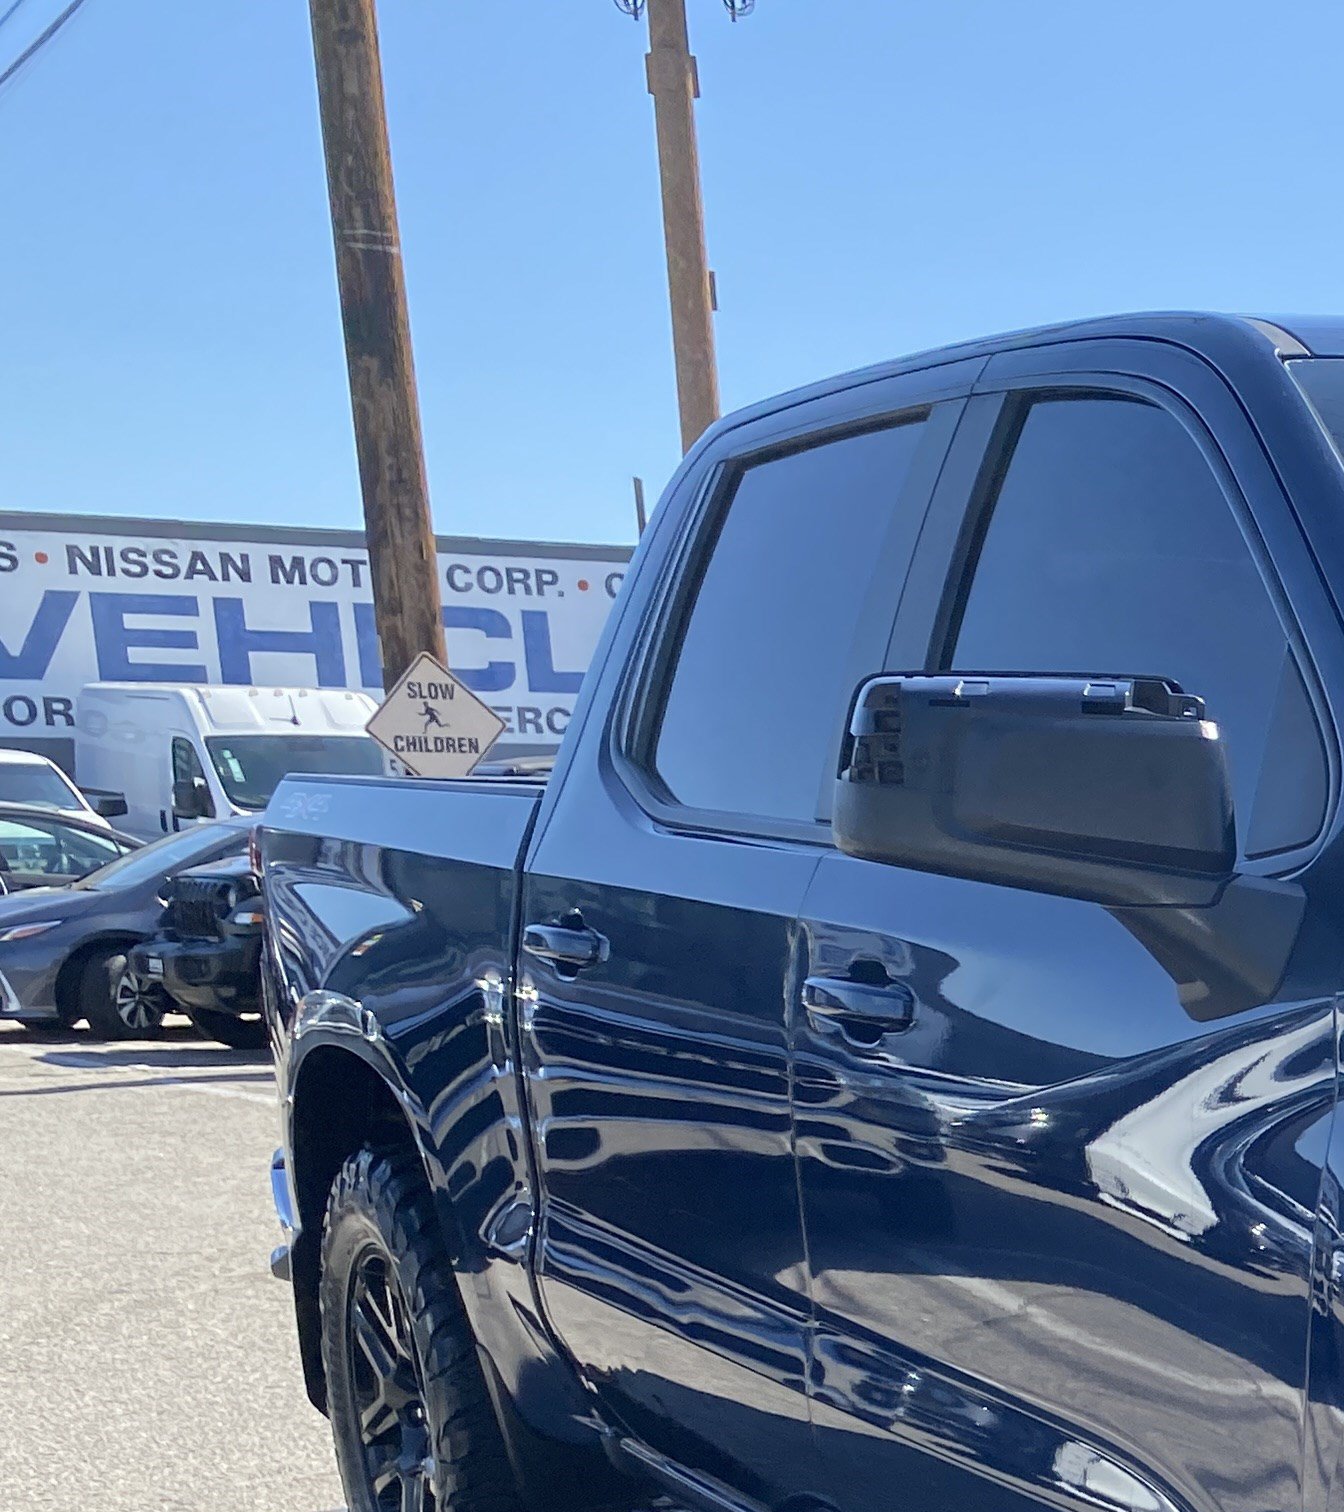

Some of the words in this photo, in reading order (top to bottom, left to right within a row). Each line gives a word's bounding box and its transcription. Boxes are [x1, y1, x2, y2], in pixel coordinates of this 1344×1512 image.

[65, 544, 252, 583] NISSAN
[268, 554, 368, 588] MOT
[446, 563, 565, 598] CORP.
[0, 589, 588, 694] VEHICL
[406, 681, 455, 700] SLOW
[393, 735, 480, 754] CHILDREN
